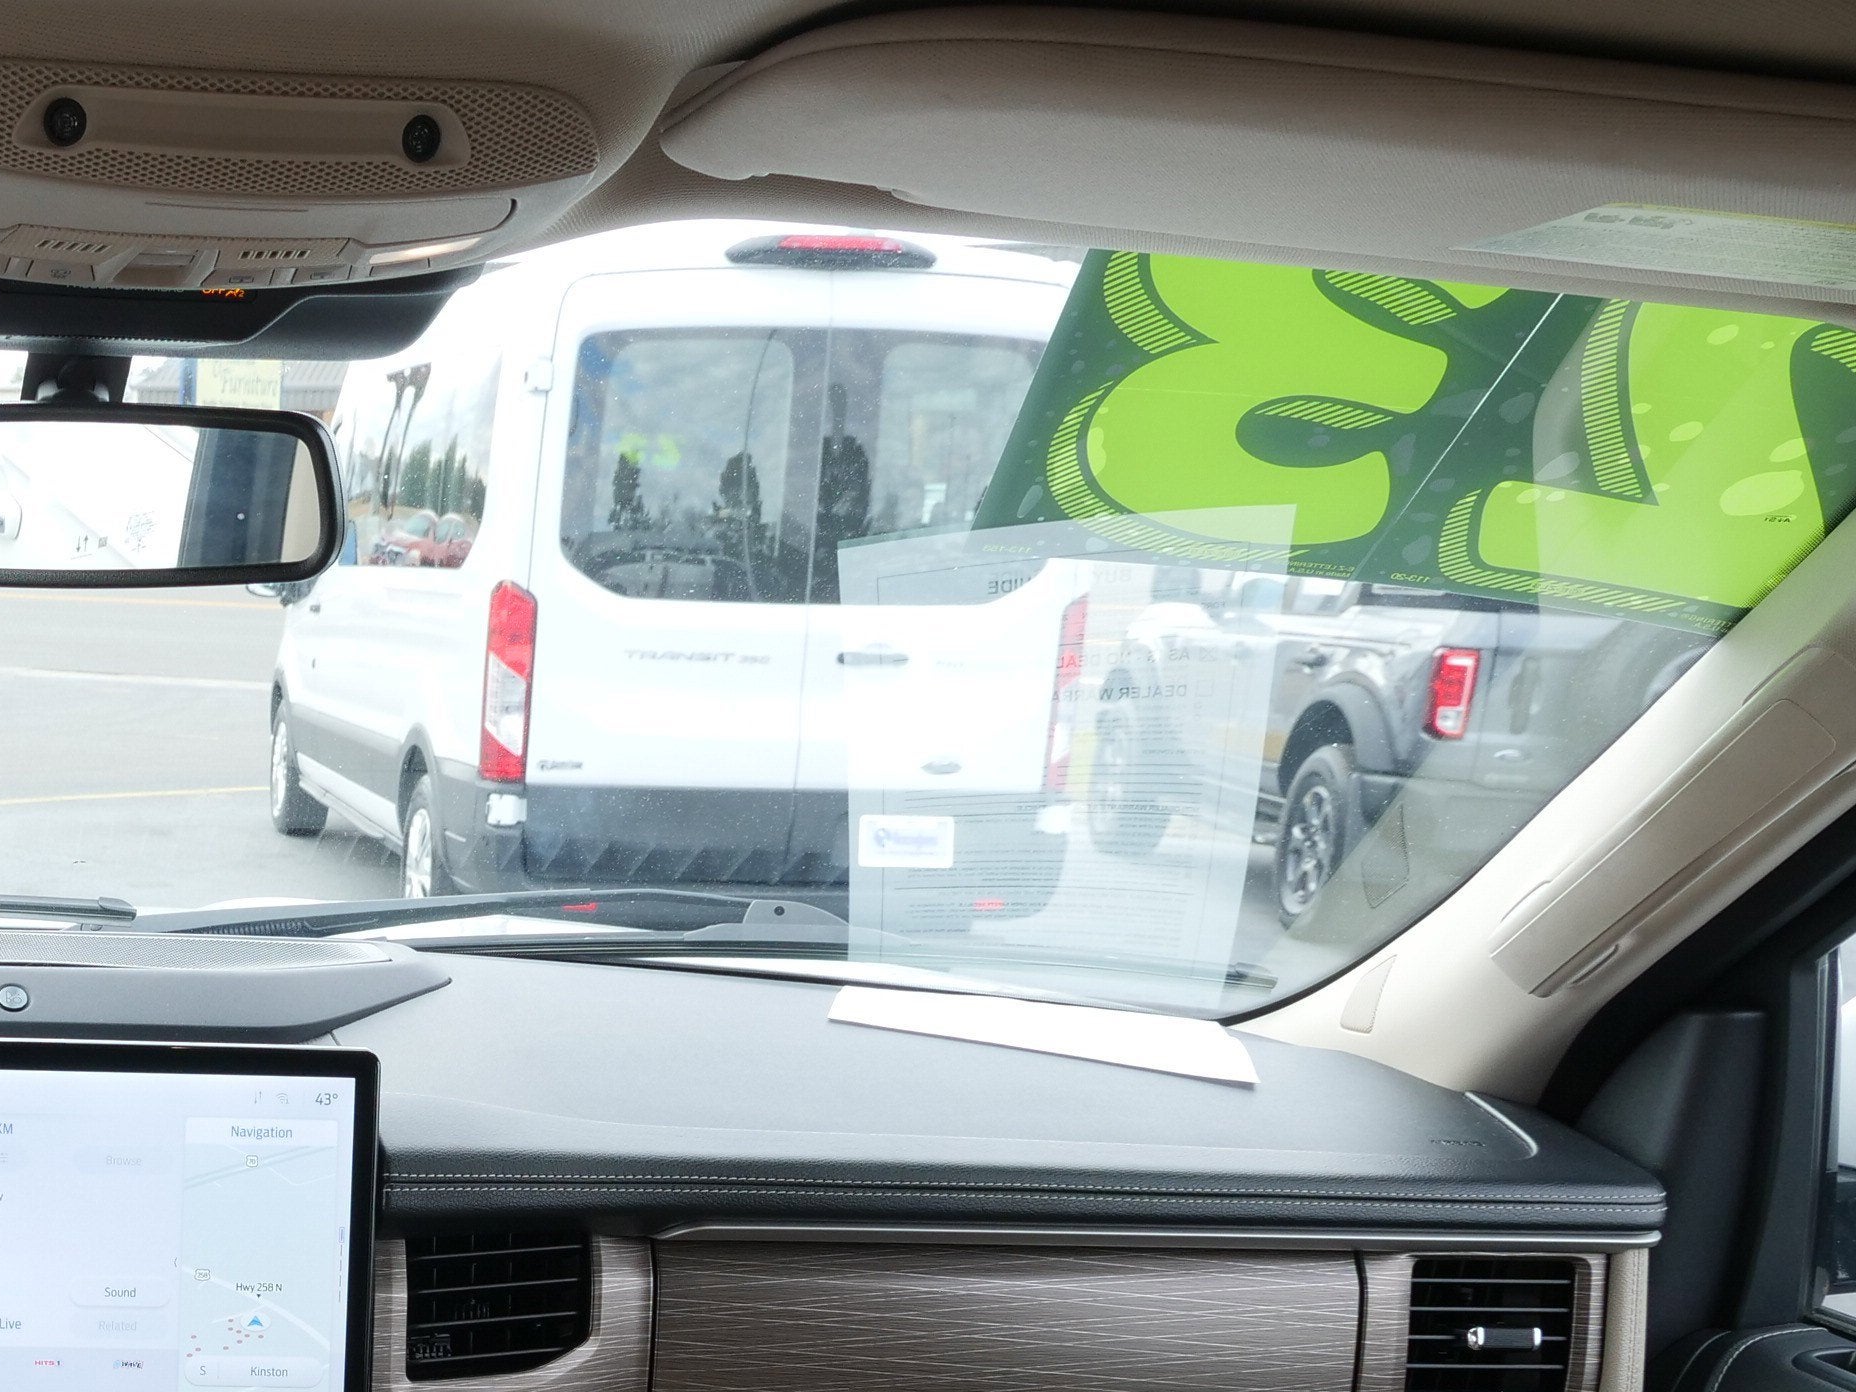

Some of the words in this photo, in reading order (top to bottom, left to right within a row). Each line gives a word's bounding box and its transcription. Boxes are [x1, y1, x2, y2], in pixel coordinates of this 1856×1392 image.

[314, 1092, 339, 1106] 43°
[230, 1125, 293, 1140] Navigation
[105, 1155, 143, 1167] Browse
[104, 1287, 137, 1299] Sound
[235, 1282, 255, 1293] Hwy
[256, 1282, 274, 1292] 258
[275, 1283, 283, 1292] N
[98, 1320, 137, 1332] Related
[199, 1365, 207, 1377] S
[250, 1365, 288, 1377] Kinston
